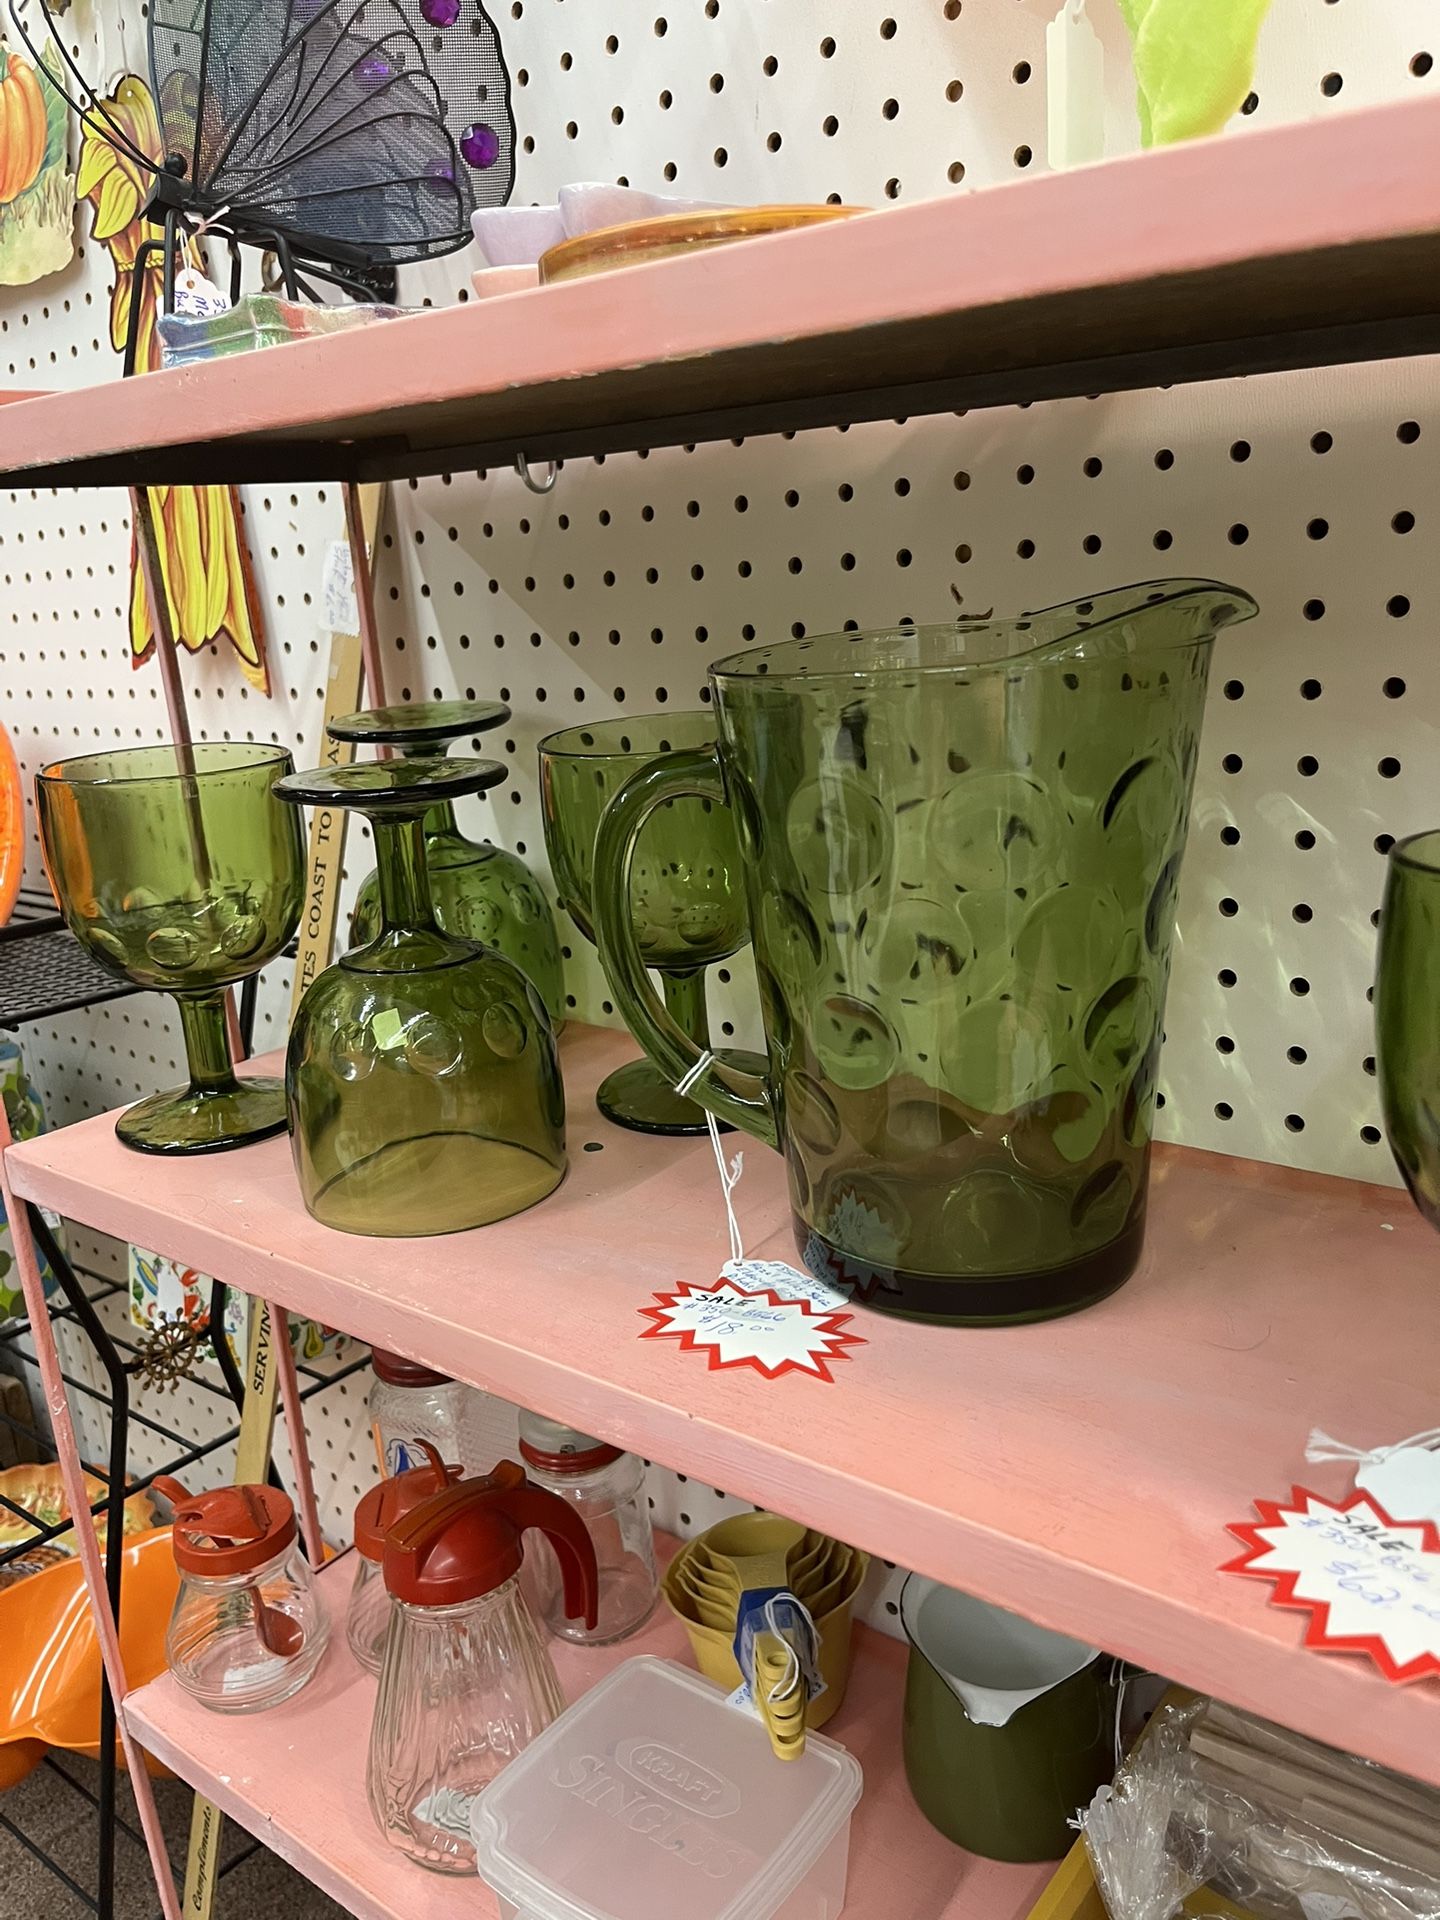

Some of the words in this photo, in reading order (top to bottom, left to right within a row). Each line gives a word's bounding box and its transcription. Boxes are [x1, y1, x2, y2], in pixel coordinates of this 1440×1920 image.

[317, 811, 332, 845] TO
[308, 856, 327, 939] COAST
[694, 1293, 757, 1307] SALE
[1332, 1514, 1414, 1553] SALE
[637, 1751, 722, 1802] KRAFT
[549, 1754, 746, 1880] SINGLES
[191, 1805, 212, 1912] Compliments
